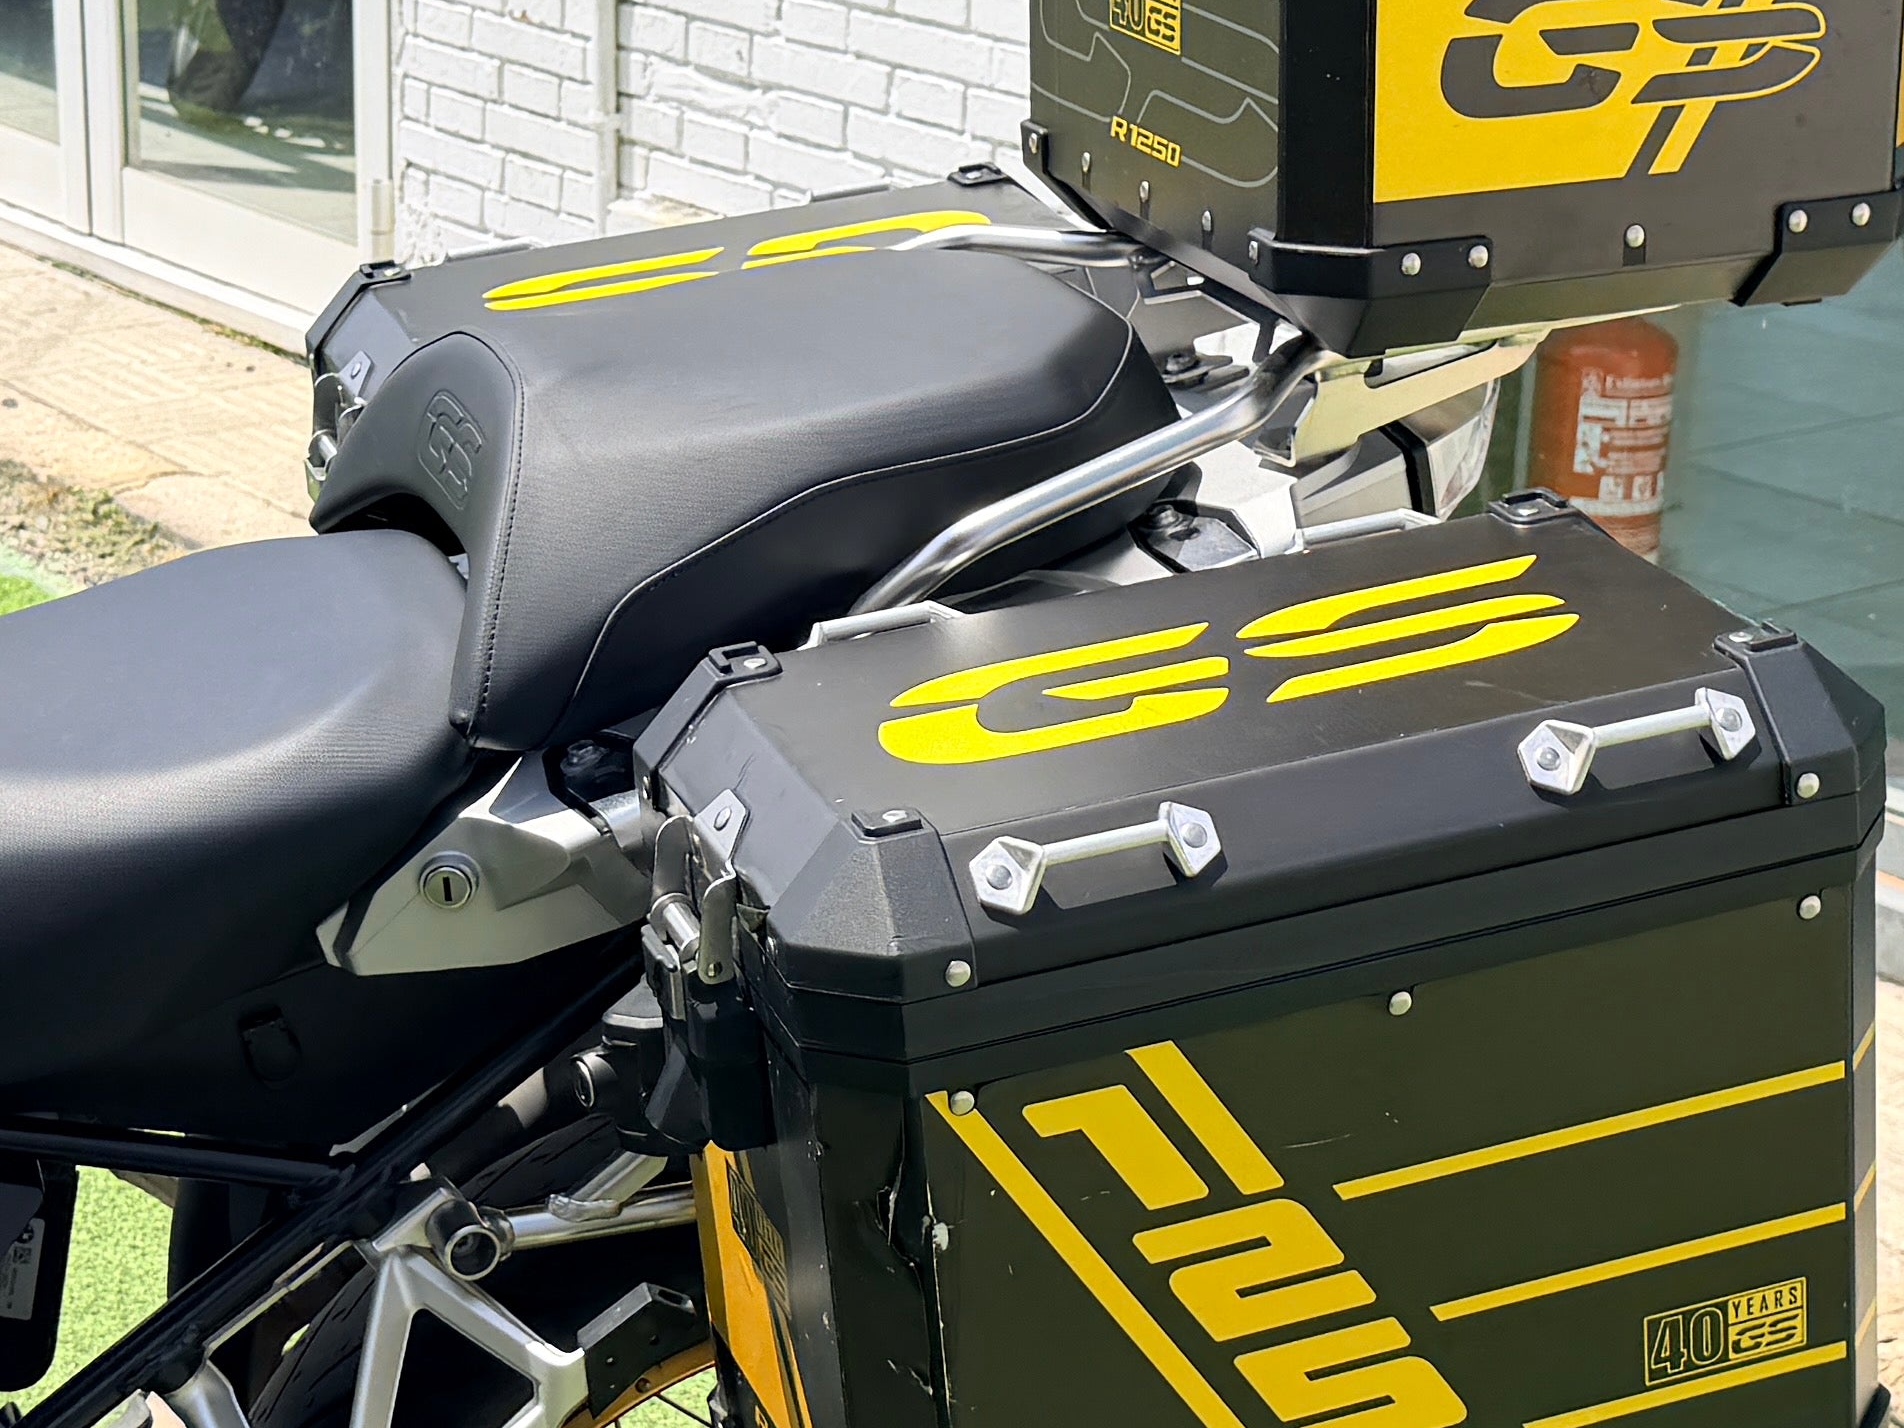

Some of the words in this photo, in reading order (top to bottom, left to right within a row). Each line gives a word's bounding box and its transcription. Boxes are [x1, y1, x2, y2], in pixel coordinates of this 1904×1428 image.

[1147, 5, 1177, 43] GS
[878, 553, 1579, 764] GS
[1732, 1285, 1799, 1319] YEARS
[1651, 1307, 1725, 1373] 40
[1731, 1313, 1800, 1354] GS
